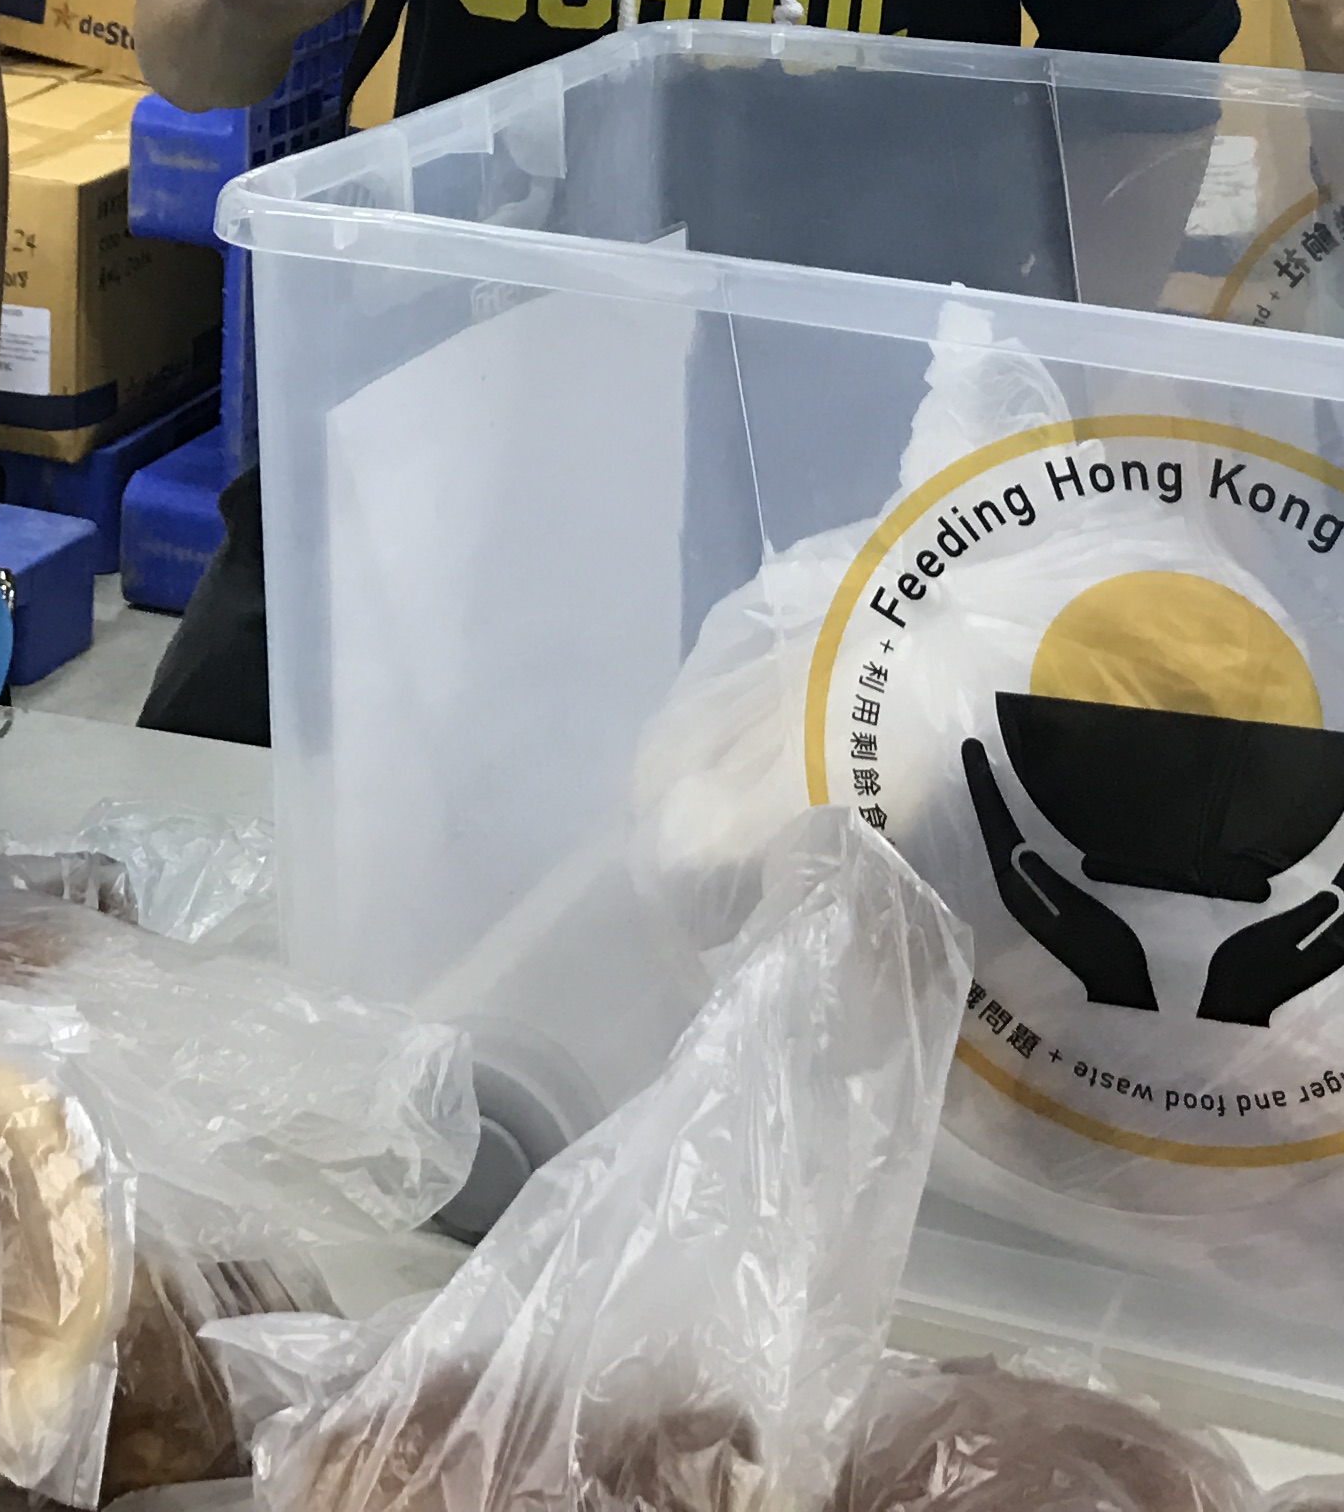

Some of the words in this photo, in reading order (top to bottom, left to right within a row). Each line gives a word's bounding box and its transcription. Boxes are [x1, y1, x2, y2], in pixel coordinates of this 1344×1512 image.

[79, 14, 135, 50] deSt
[870, 483, 1036, 629] Feeding
[1046, 456, 1183, 504] Hong
[1073, 1060, 1154, 1102] waste
[1165, 1094, 1226, 1117] food
[1238, 1089, 1287, 1117] and
